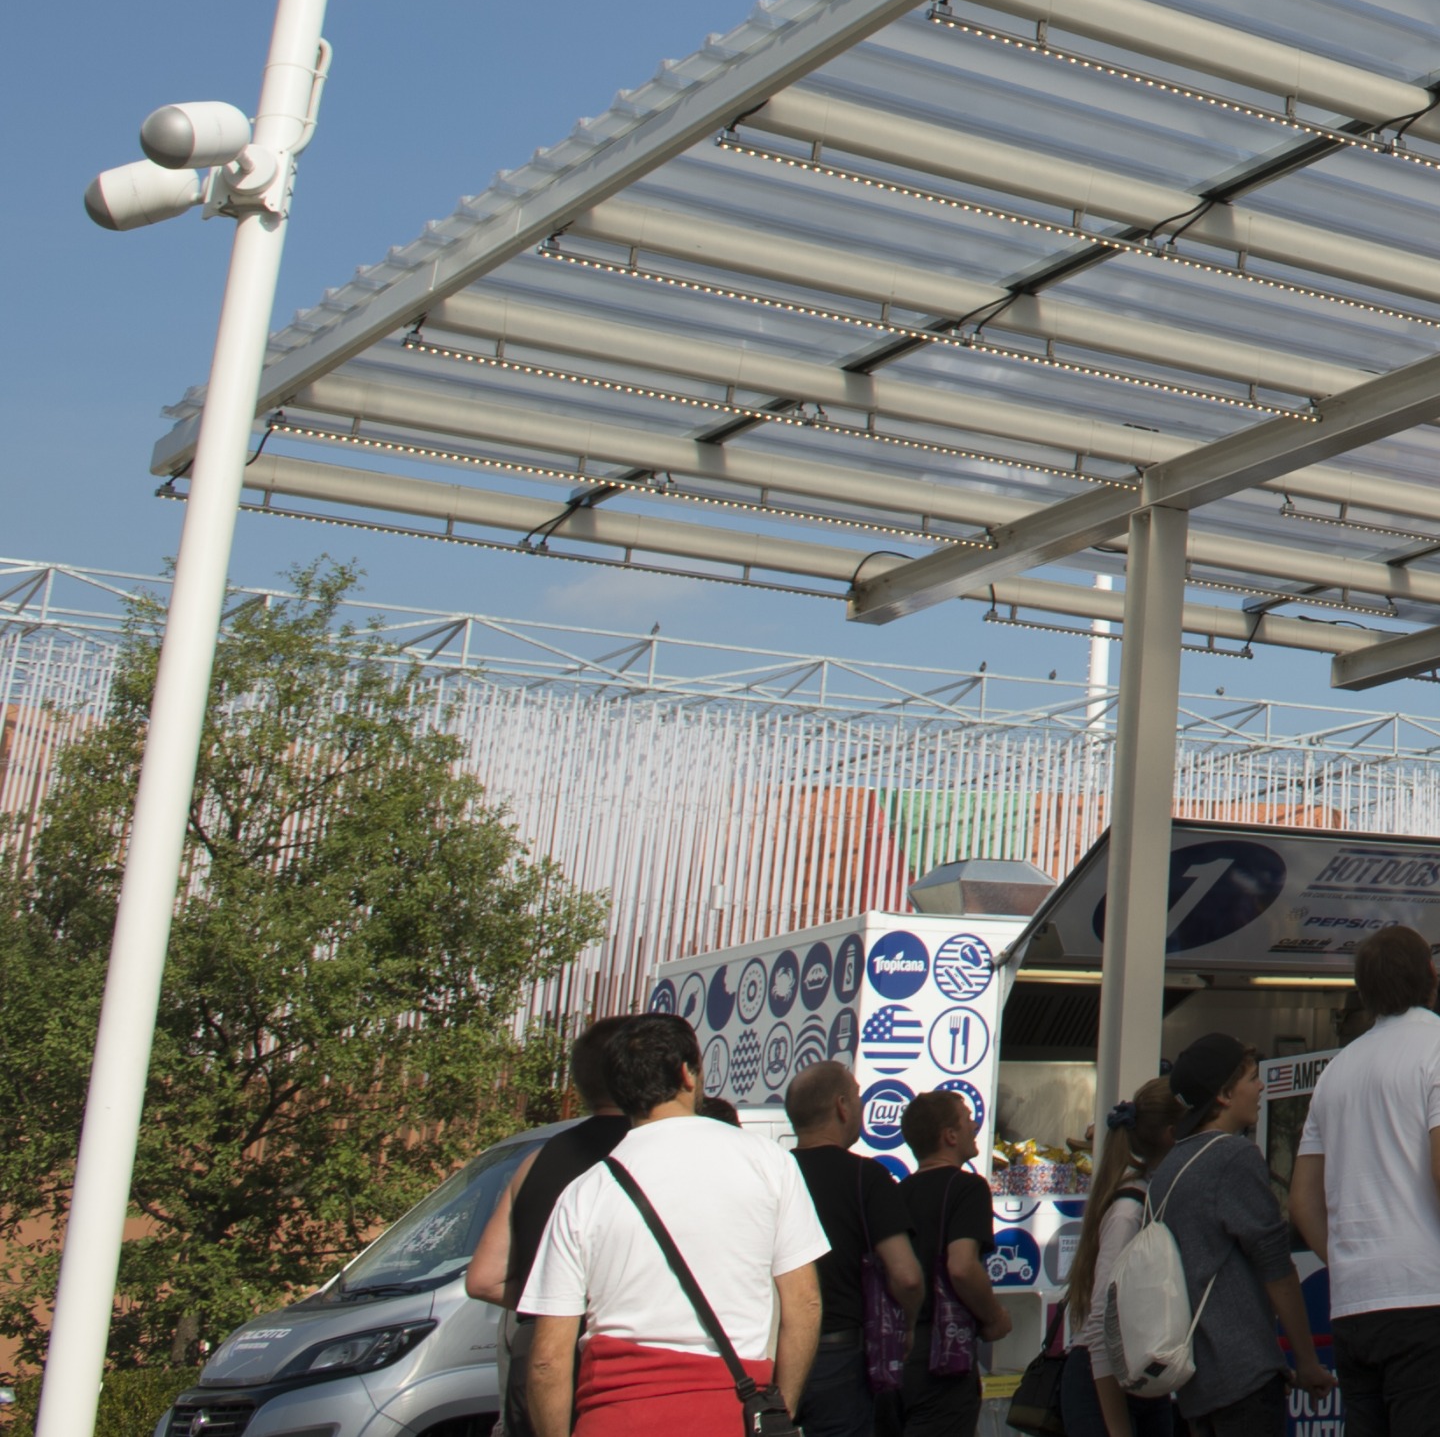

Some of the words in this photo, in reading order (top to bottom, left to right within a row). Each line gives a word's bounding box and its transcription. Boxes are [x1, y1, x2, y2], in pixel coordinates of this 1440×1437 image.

[1315, 856, 1384, 883] HOT
[873, 952, 924, 973] Tropicana
[1293, 1057, 1333, 1090] AME
